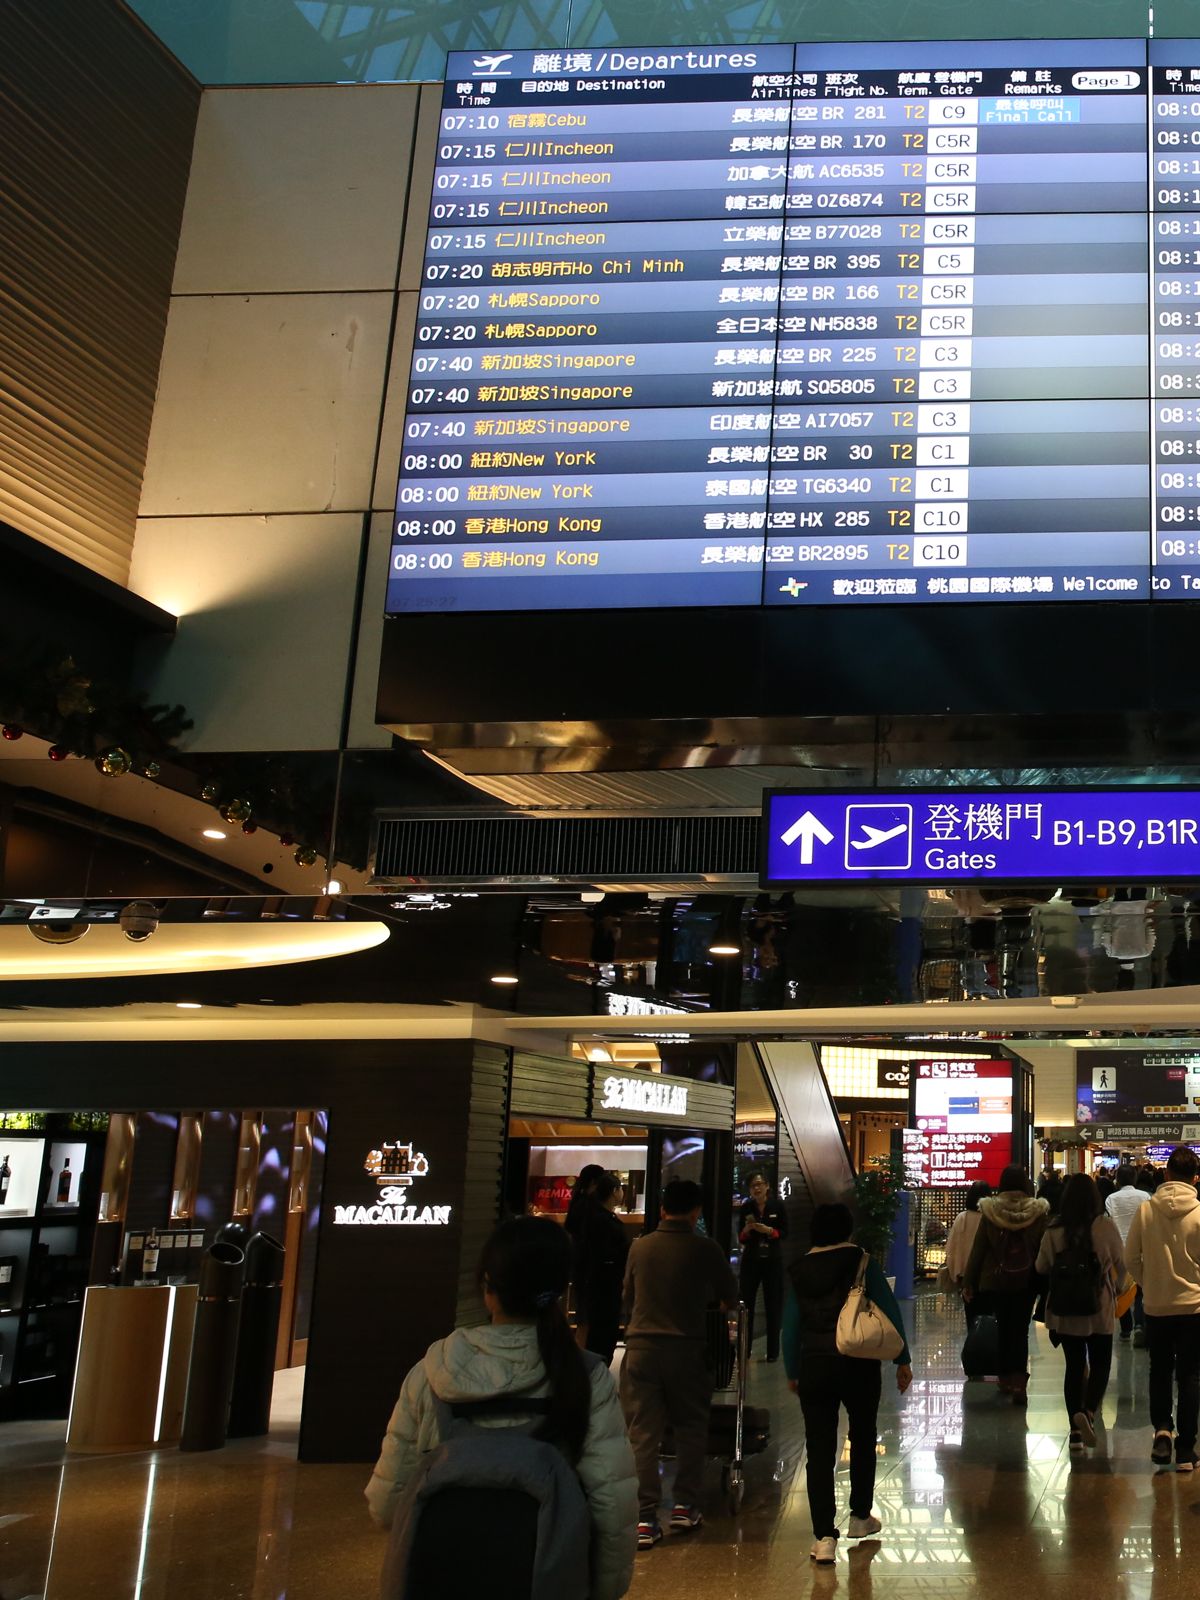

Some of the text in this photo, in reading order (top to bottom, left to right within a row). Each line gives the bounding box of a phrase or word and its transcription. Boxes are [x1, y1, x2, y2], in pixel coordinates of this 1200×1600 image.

[533, 53, 757, 75] 離境/Departures
[521, 79, 665, 92] 目的地 Destination
[752, 73, 858, 87] 航空公司 班次
[934, 71, 983, 84] 登機門
[1078, 74, 1134, 88] Page 1
[752, 85, 888, 98] Airlines Flight No.
[898, 84, 973, 97] Term. Gate
[1005, 84, 1062, 94] Remarks
[459, 94, 491, 106] Time
[444, 114, 586, 130] 07:10 宿霧Cebu
[732, 105, 966, 123] 長榮航空 BR 281 T2 C9
[986, 111, 1072, 122] Final Call
[437, 171, 611, 188] 07:15 仁川Incheon
[819, 164, 884, 179] AC6535
[902, 164, 922, 178] T2
[934, 164, 970, 178] C5R
[430, 232, 606, 250] 07:15 仁川Incheon
[724, 224, 968, 242] 立榮航空 B77028 T2 C5R
[419, 322, 597, 342] 07:20 札幌Sapporo
[716, 316, 966, 334] 全日本空 NH5838 T2 C5R
[401, 484, 593, 503] 08:00 紐約New York
[705, 478, 954, 496] 泰國航空 TG6340 T2 C1
[927, 577, 1054, 594] 桃園國際機場
[1064, 576, 1138, 591] Welcome
[1150, 575, 1170, 590] to
[924, 802, 1043, 842] 登機門
[1054, 820, 1198, 850] B1-B9,B1R
[924, 848, 996, 870] Gates
[621, 1078, 688, 1116] MACALLAN
[538, 1189, 572, 1198] REMIX
[333, 1205, 452, 1224] MACALLAN
